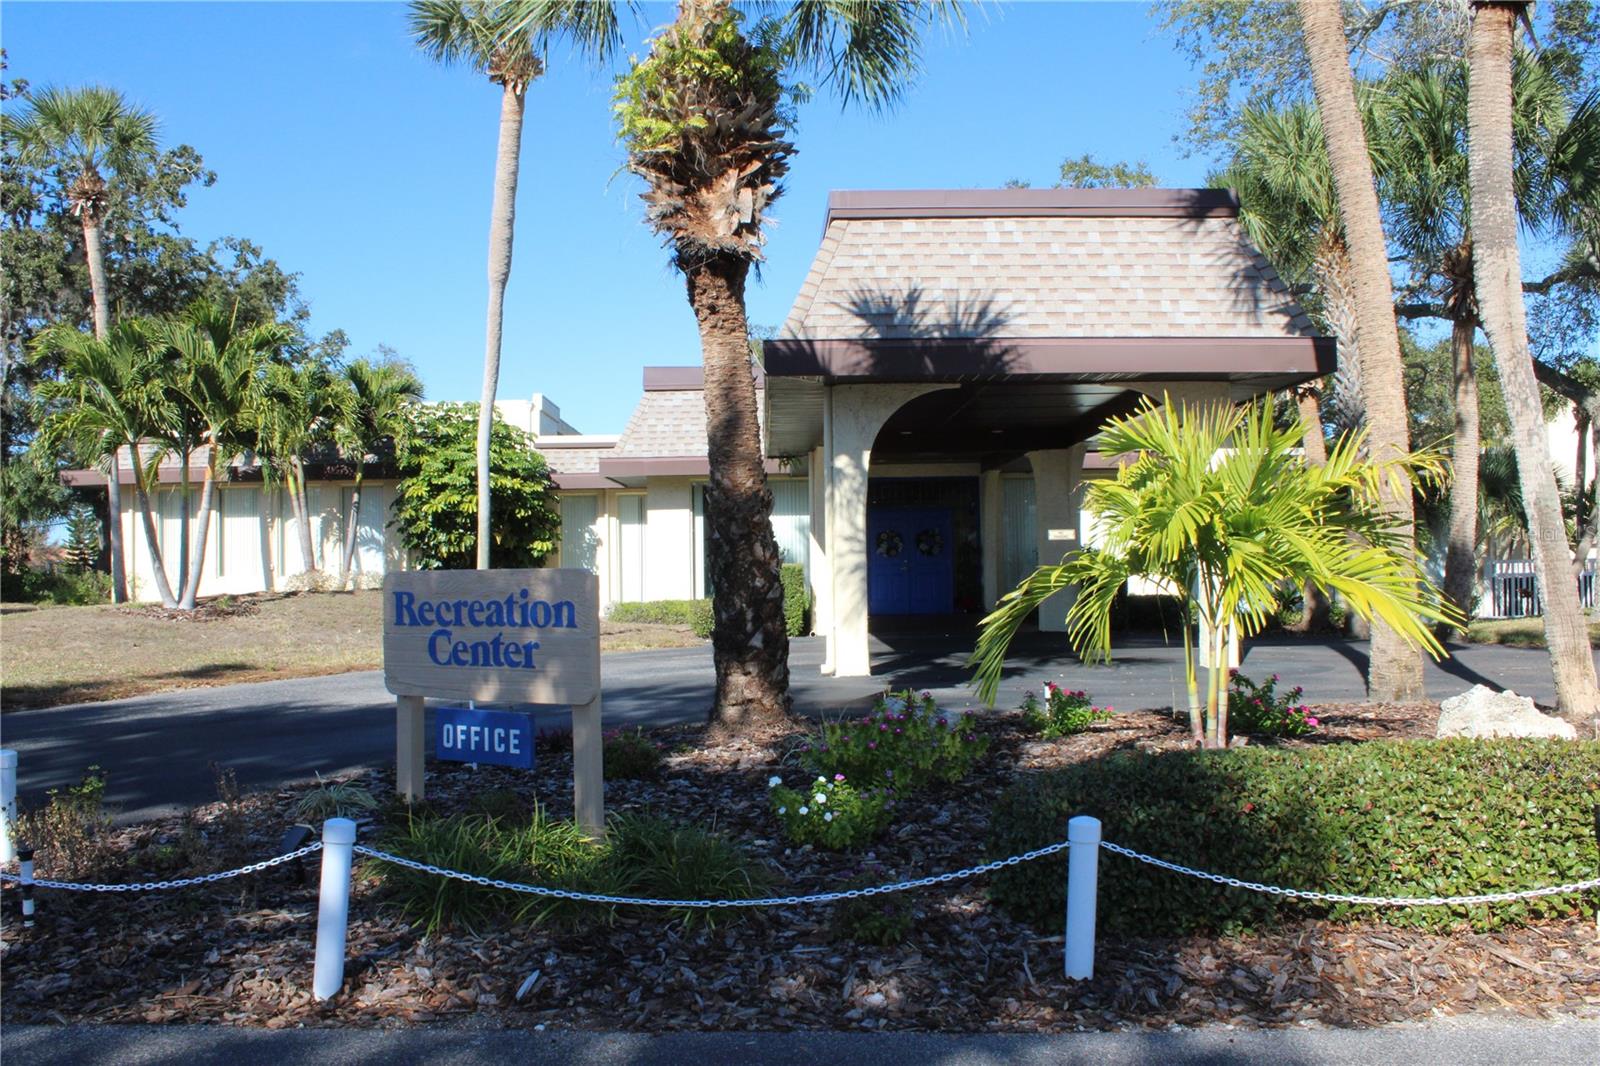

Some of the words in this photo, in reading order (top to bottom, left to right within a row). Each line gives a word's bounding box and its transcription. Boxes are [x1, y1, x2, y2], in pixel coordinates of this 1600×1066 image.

[393, 588, 577, 628] Recreation
[428, 629, 540, 669] Center
[442, 723, 521, 754] OFFICE
